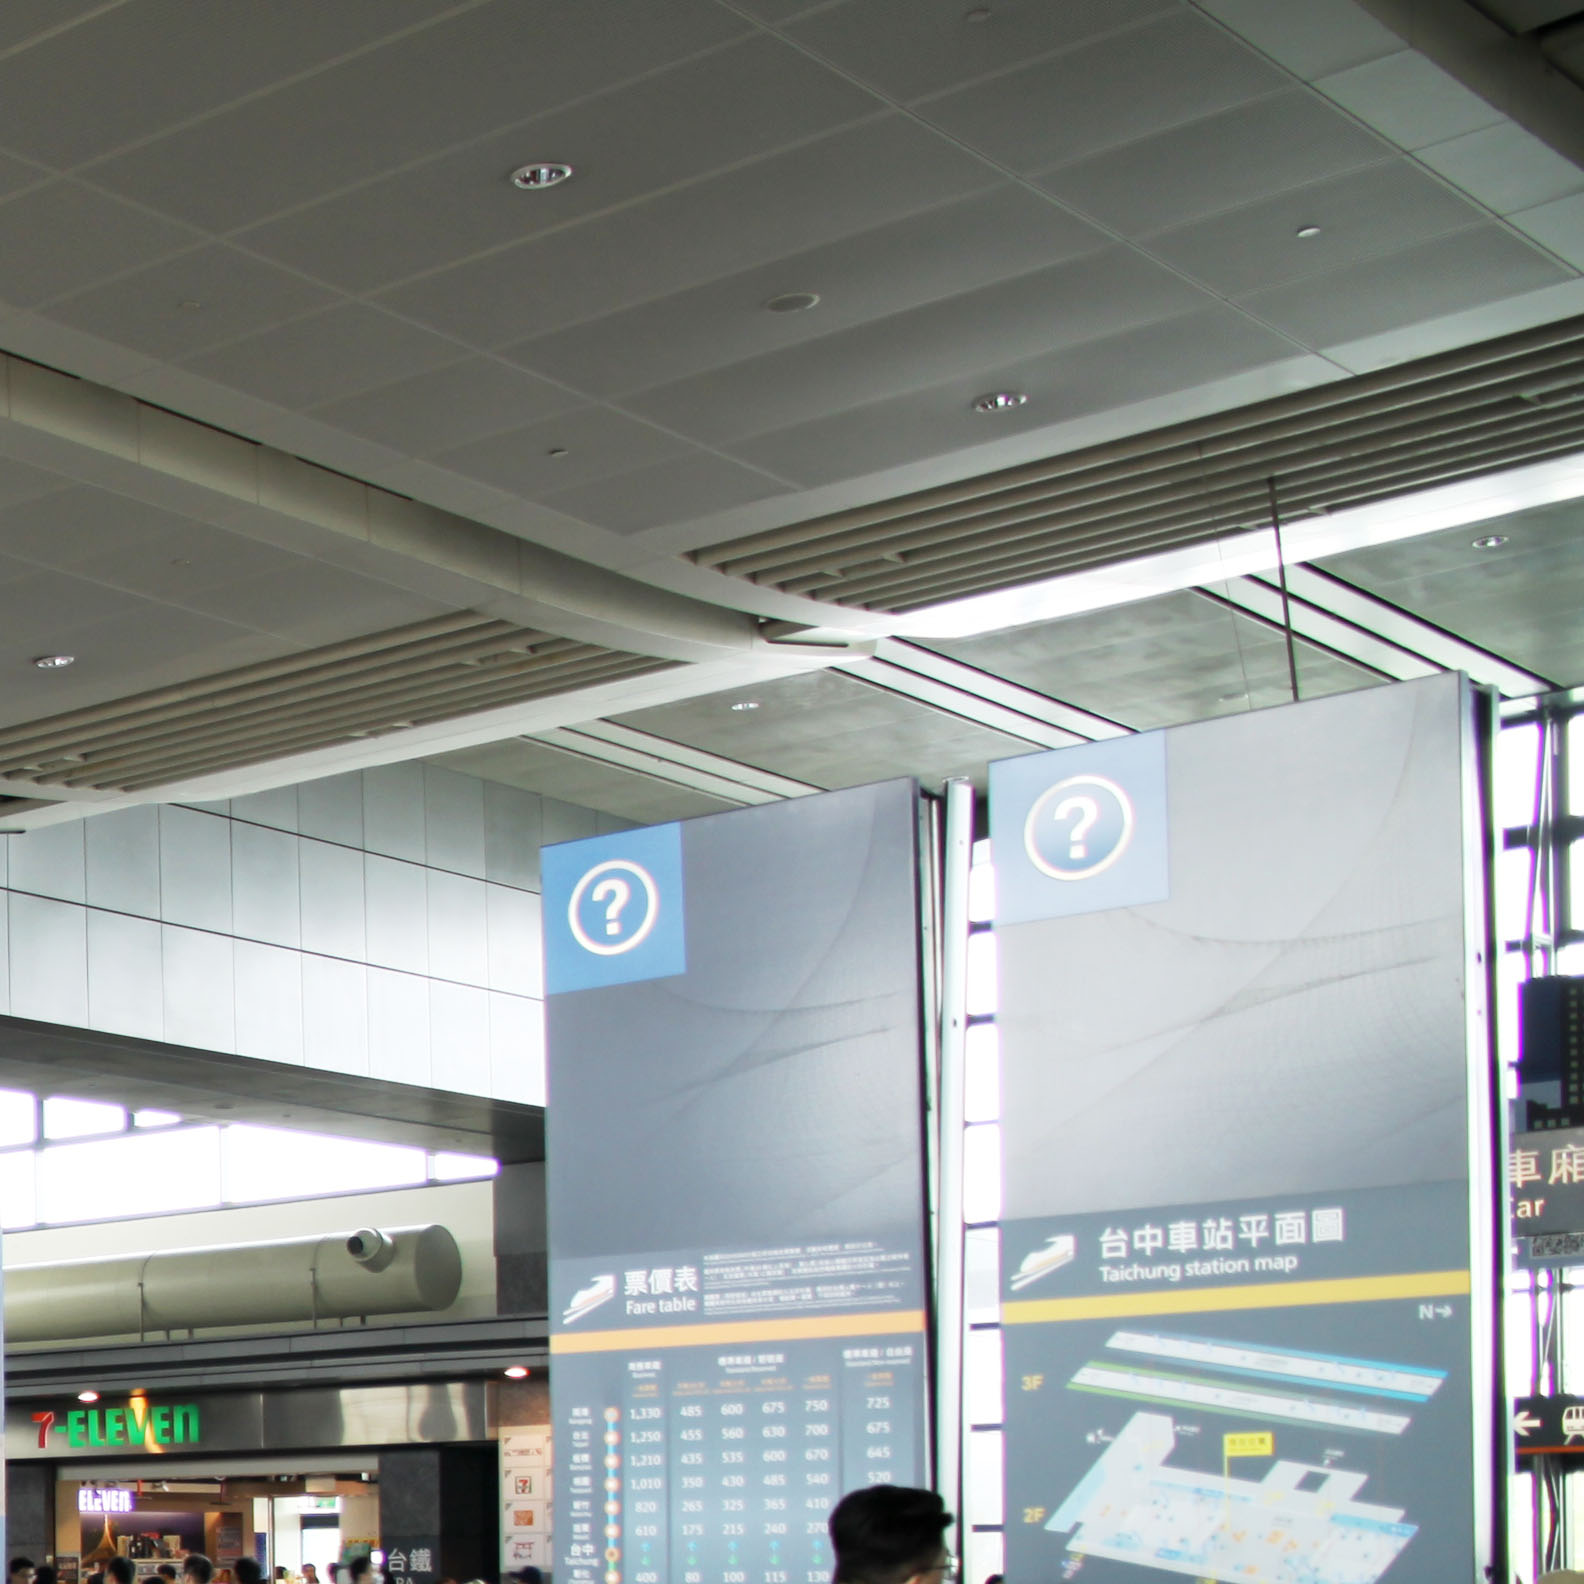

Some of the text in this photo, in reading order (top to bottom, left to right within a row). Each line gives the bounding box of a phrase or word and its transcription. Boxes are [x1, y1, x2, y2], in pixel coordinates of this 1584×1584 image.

[1510, 1198, 1545, 1219] ar
[1098, 1207, 1345, 1260] 台中車站平面圖
[1098, 1253, 1299, 1284] Taichung station map
[623, 1266, 698, 1297] 票價表
[625, 1295, 696, 1315] Fare table
[1021, 1375, 1044, 1392] 3F
[570, 1542, 595, 1557] 台中
[388, 1548, 432, 1573] 台鐵
[564, 1555, 599, 1569] Taichung
